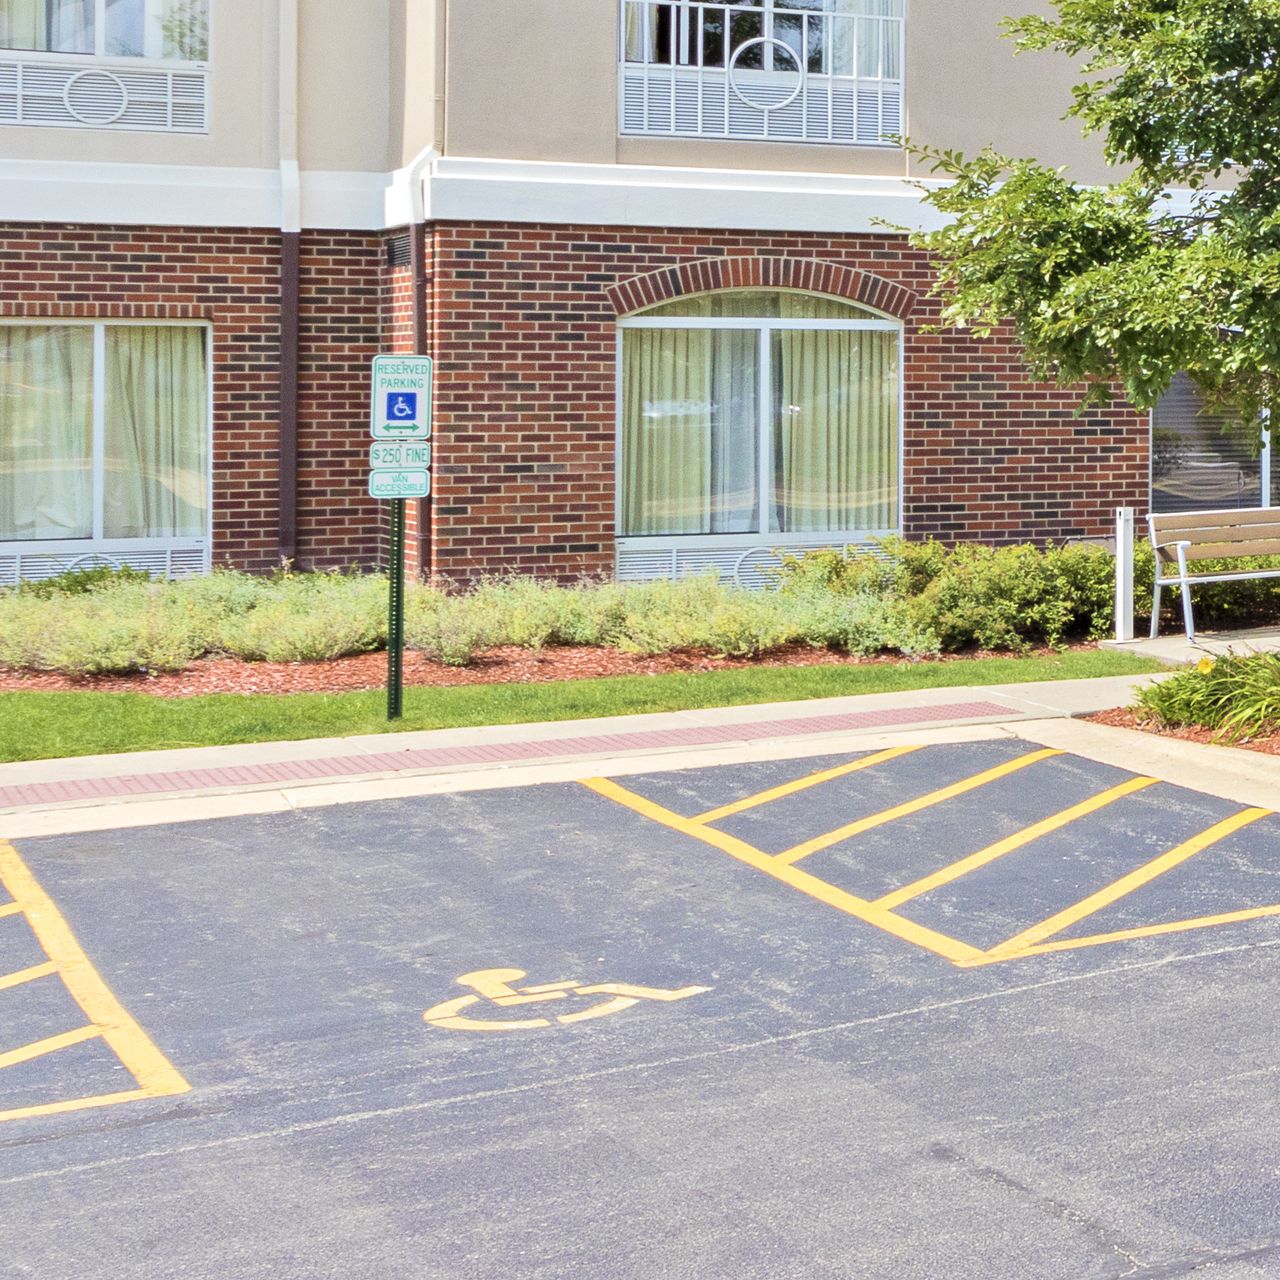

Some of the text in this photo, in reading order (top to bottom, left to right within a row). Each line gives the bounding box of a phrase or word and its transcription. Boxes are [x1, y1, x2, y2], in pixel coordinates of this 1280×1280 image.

[377, 363, 428, 375] RESERVED
[380, 378, 424, 389] PARKING
[406, 448, 427, 463] FINE
[391, 474, 408, 483] VAN
[374, 483, 425, 492] ACCESSIBLE
